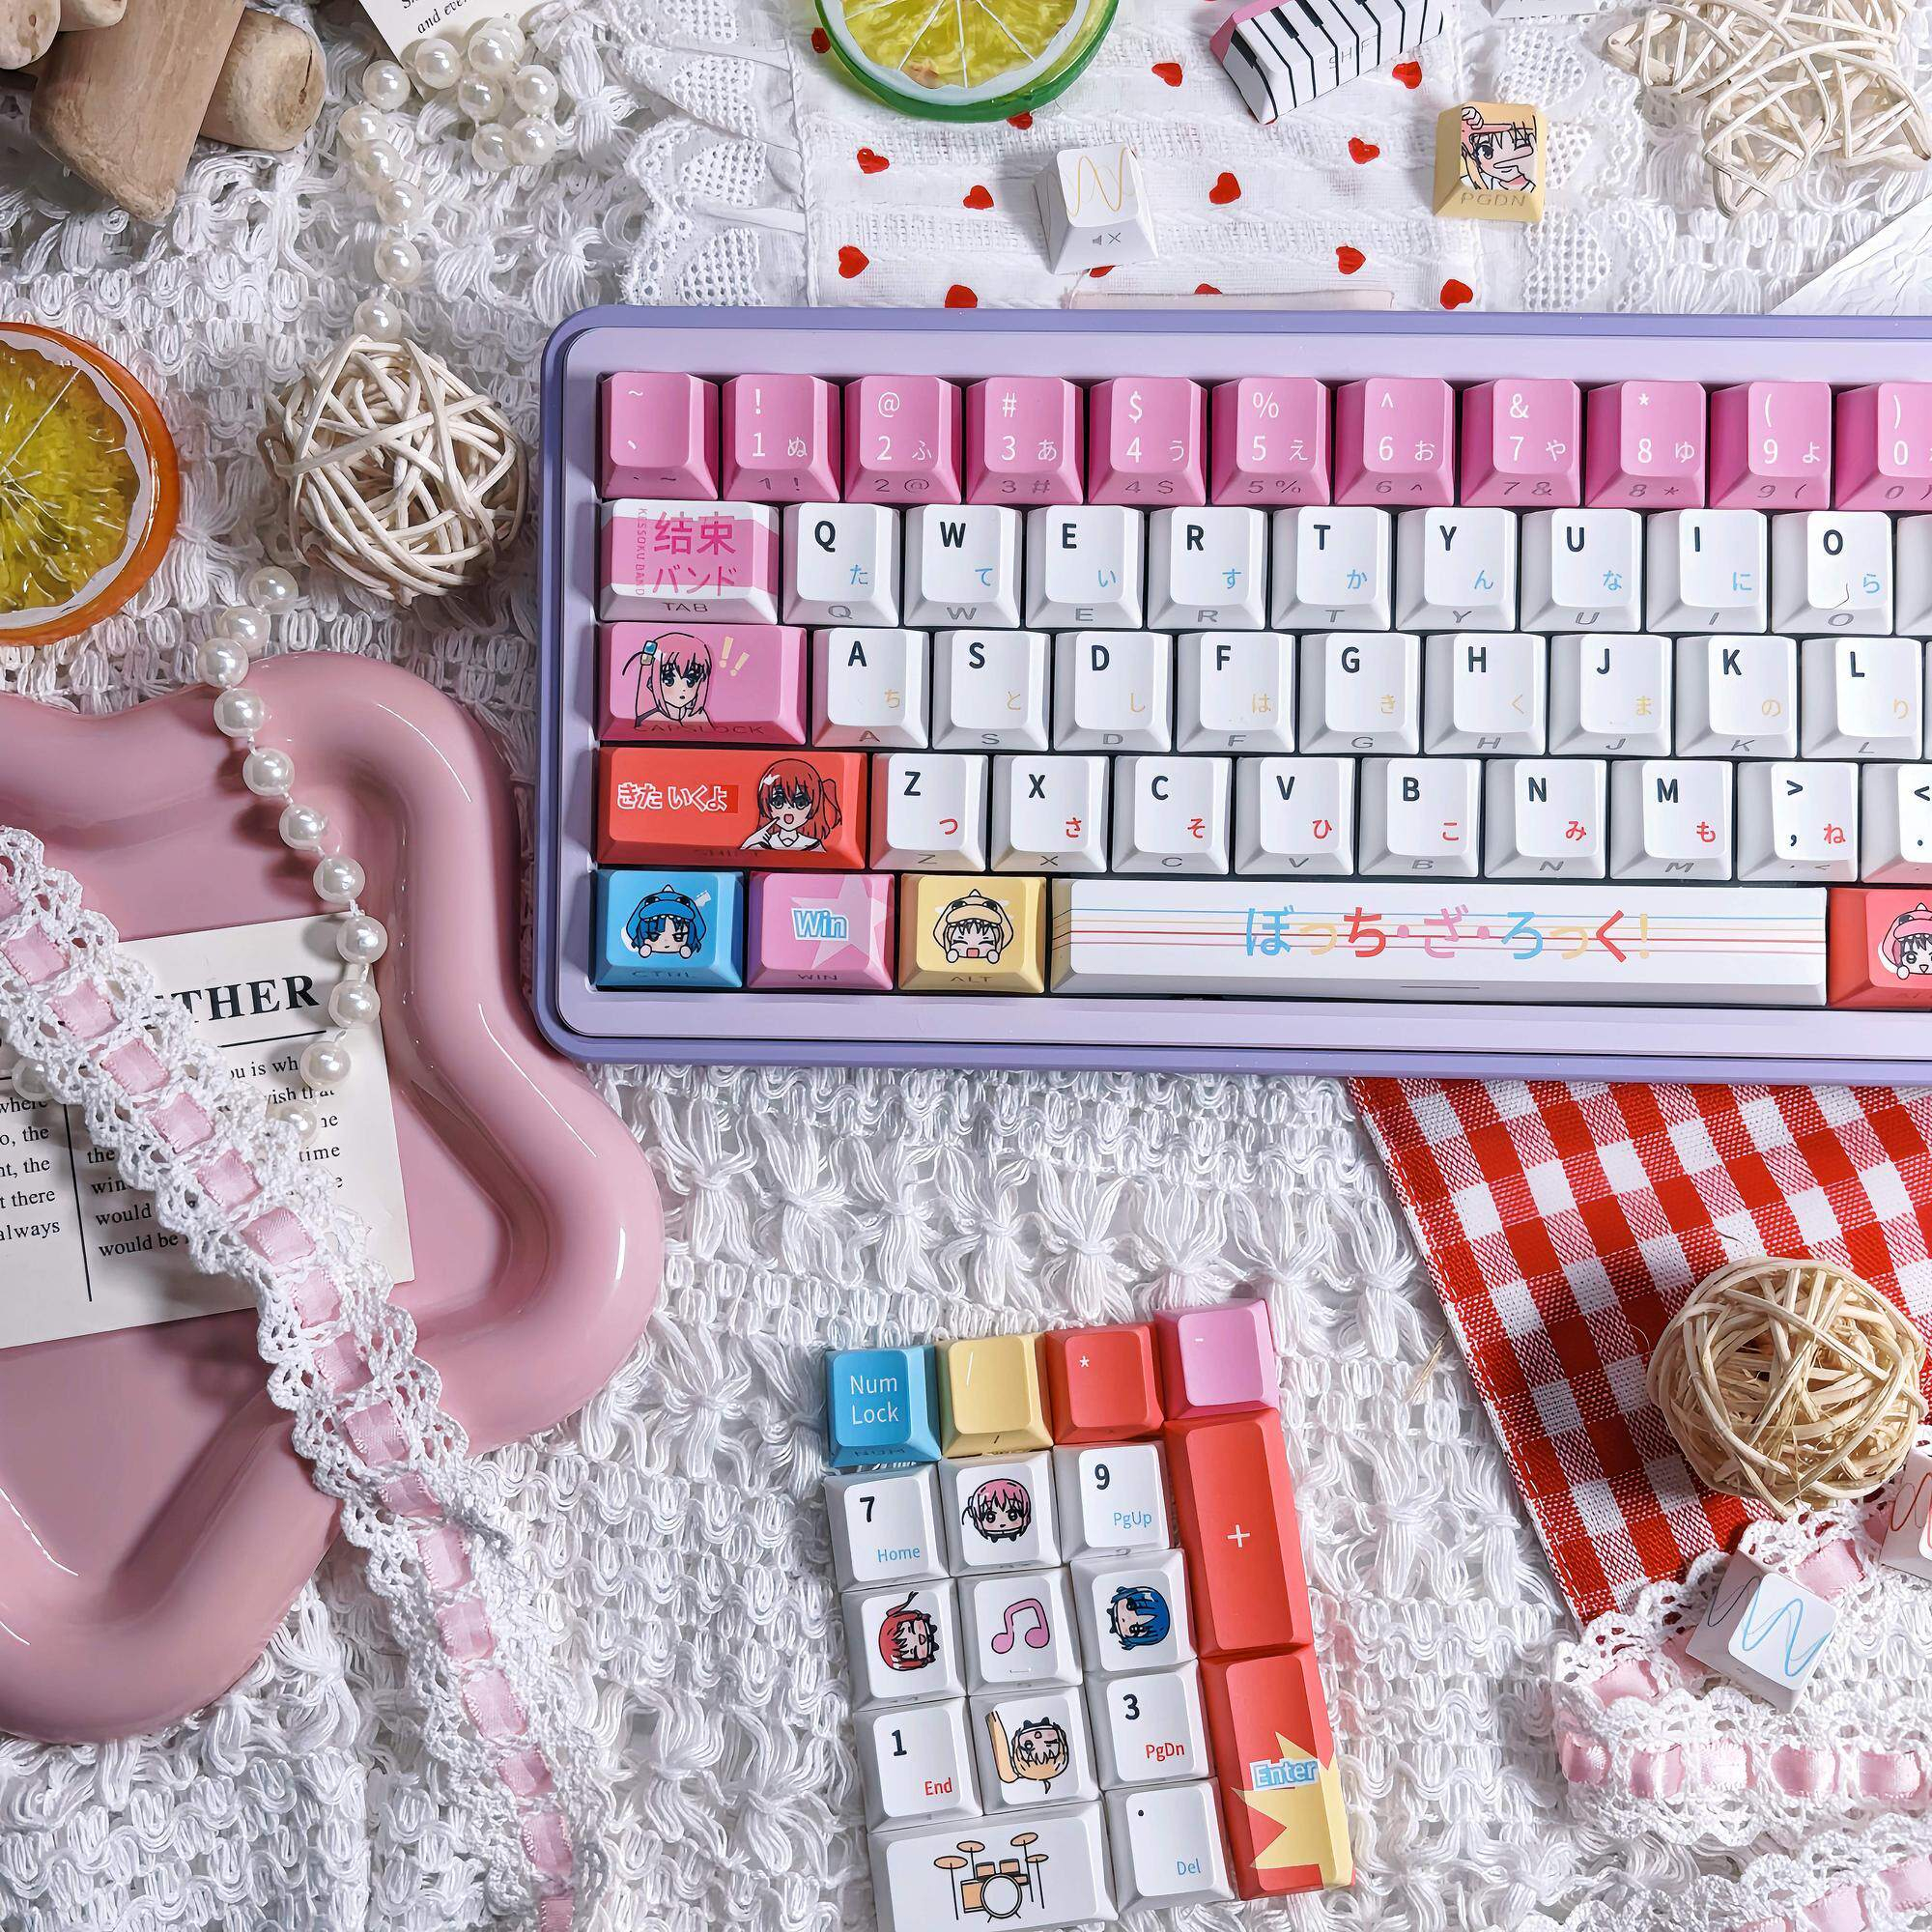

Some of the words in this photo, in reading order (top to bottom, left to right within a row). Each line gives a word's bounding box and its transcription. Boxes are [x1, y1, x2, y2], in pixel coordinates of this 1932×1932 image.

[417, 9, 440, 34] and
[443, 0, 470, 15] eve
[1461, 192, 1525, 208] PGDN
[752, 433, 765, 457] 1
[787, 437, 808, 458] ぬ
[876, 436, 893, 461] 2
[912, 440, 932, 461] ふ
[1001, 436, 1015, 461] 3
[1037, 440, 1057, 462] あ
[1126, 437, 1142, 463] 4
[1169, 440, 1184, 462] う
[1251, 436, 1266, 462] 5
[1289, 440, 1308, 461] え
[1378, 436, 1393, 461] 6
[1414, 440, 1435, 461] お
[1509, 437, 1524, 462] 7
[1546, 440, 1566, 462] や
[1638, 439, 1652, 463] 8
[1675, 440, 1695, 463] ゆ
[1763, 440, 1778, 465] 9
[1803, 442, 1820, 463] よ
[1893, 440, 1909, 466] 0
[874, 479, 890, 492] 2
[1001, 481, 1016, 493] 3
[1124, 481, 1141, 492] 4
[1248, 481, 1264, 494] 5
[1376, 481, 1392, 494] 6
[1503, 481, 1520, 496] 7
[1629, 484, 1647, 497] 8
[814, 521, 836, 553] Q
[940, 523, 967, 548] W
[1063, 524, 1076, 550] E
[1187, 525, 1204, 551] R
[1314, 525, 1331, 551] T
[1439, 526, 1457, 552] Y
[1566, 526, 1585, 553] U
[1693, 526, 1700, 553] I
[1823, 529, 1843, 555] O
[653, 564, 738, 597] バンド
[850, 564, 868, 585] た
[975, 568, 993, 586] て
[1098, 569, 1116, 587] い
[1222, 568, 1241, 588] す
[1347, 569, 1368, 589] か
[1474, 570, 1493, 590] ん
[1603, 570, 1622, 591] な
[1732, 571, 1752, 591] に
[1862, 573, 1880, 594] ら
[661, 603, 707, 612] TAB
[828, 606, 852, 619] Q
[948, 606, 977, 622] W
[1075, 609, 1094, 622] E
[1197, 610, 1218, 622] R
[1325, 610, 1345, 623] T
[1452, 610, 1472, 624] Y
[1576, 611, 1600, 626] U
[1709, 612, 1719, 626] I
[1828, 613, 1854, 626] O
[848, 641, 867, 667] A
[968, 642, 985, 668] S
[1092, 645, 1110, 670] D
[1216, 645, 1231, 670] F
[1341, 646, 1360, 674] G
[1467, 646, 1487, 672] H
[1596, 648, 1610, 675] J
[1722, 648, 1742, 675] K
[1850, 651, 1865, 678] L
[884, 688, 900, 708] ち
[1007, 691, 1022, 711] と
[1129, 693, 1146, 713] し
[1252, 694, 1271, 713] は
[1379, 694, 1396, 714] き
[1511, 694, 1524, 714] く
[1635, 696, 1653, 716] ま
[1761, 697, 1781, 717] の
[1892, 698, 1909, 719] り
[859, 730, 880, 742] A
[981, 734, 1001, 745] S
[1102, 734, 1123, 745] D
[1227, 735, 1247, 747] F
[1351, 736, 1374, 749] G
[1477, 737, 1501, 749] H
[1605, 738, 1626, 750] J
[1730, 740, 1755, 752] K
[1857, 742, 1875, 753] L
[904, 771, 922, 796] Z
[1028, 774, 1045, 799] X
[1151, 775, 1169, 800] C
[1276, 776, 1295, 801] V
[1403, 777, 1420, 802] B
[1528, 777, 1547, 802] N
[1657, 779, 1679, 803] M
[939, 819, 958, 835] つ
[1065, 817, 1081, 838] さ
[1187, 817, 1206, 838] そ
[1312, 820, 1332, 839] ひ
[1441, 822, 1460, 841] こ
[1565, 821, 1586, 841] み
[1696, 821, 1716, 842] も
[1824, 823, 1846, 844] ね
[918, 854, 937, 865] Z
[1039, 856, 1059, 866] X
[1161, 857, 1182, 867] C
[1289, 858, 1309, 868] V
[1412, 859, 1434, 869] B
[1540, 861, 1564, 871] N
[1664, 862, 1694, 872] M
[794, 911, 847, 939] Win
[798, 973, 839, 981] WIN
[951, 975, 992, 983] ALT
[155, 975, 320, 1024] THER
[251, 1062, 267, 1076] is
[23, 1126, 49, 1142] the
[87, 1148, 115, 1163] the
[299, 1146, 340, 1163] time
[24, 1158, 50, 1174] the
[91, 1177, 133, 1194] win
[12, 1191, 55, 1208] there
[96, 1203, 152, 1226] would
[99, 1235, 153, 1257] would
[157, 1233, 178, 1247] be
[850, 1375, 897, 1395] Num
[852, 1401, 898, 1424] Lock
[1094, 1463, 1111, 1490] 9
[860, 1496, 875, 1522] 7
[1113, 1510, 1152, 1529] PgUp
[877, 1546, 921, 1563] Home
[1124, 1694, 1141, 1720] 3
[891, 1729, 908, 1757] 1
[1145, 1742, 1185, 1762] PgDn
[1256, 1761, 1317, 1787] Enter
[923, 1777, 953, 1797] End
[1177, 1858, 1201, 1875] Del
